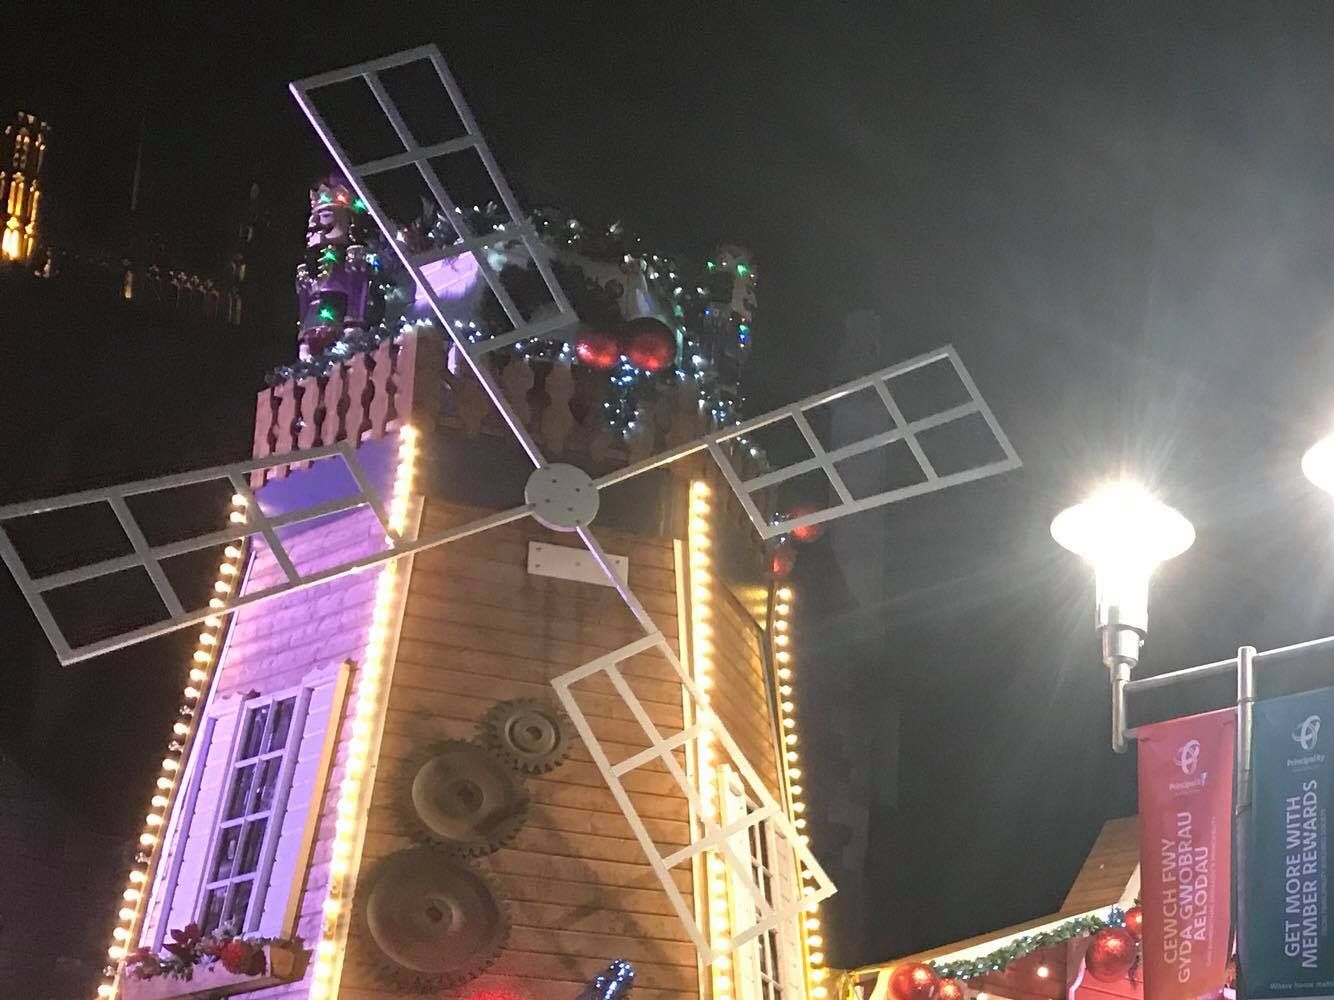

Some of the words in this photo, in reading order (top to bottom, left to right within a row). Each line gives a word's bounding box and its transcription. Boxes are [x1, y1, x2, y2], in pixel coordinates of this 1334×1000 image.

[1285, 796, 1301, 850] WITH
[1302, 779, 1318, 875] REWARDS
[1161, 838, 1177, 883] FWY
[1177, 811, 1193, 920] GWOBRAU
[1194, 846, 1208, 941] AELODAU
[1285, 854, 1301, 914] MORE
[1162, 890, 1178, 964] CEWCH
[1178, 927, 1193, 983] GYDA
[1284, 921, 1300, 957] GET
[1302, 879, 1318, 968] MEMBER
